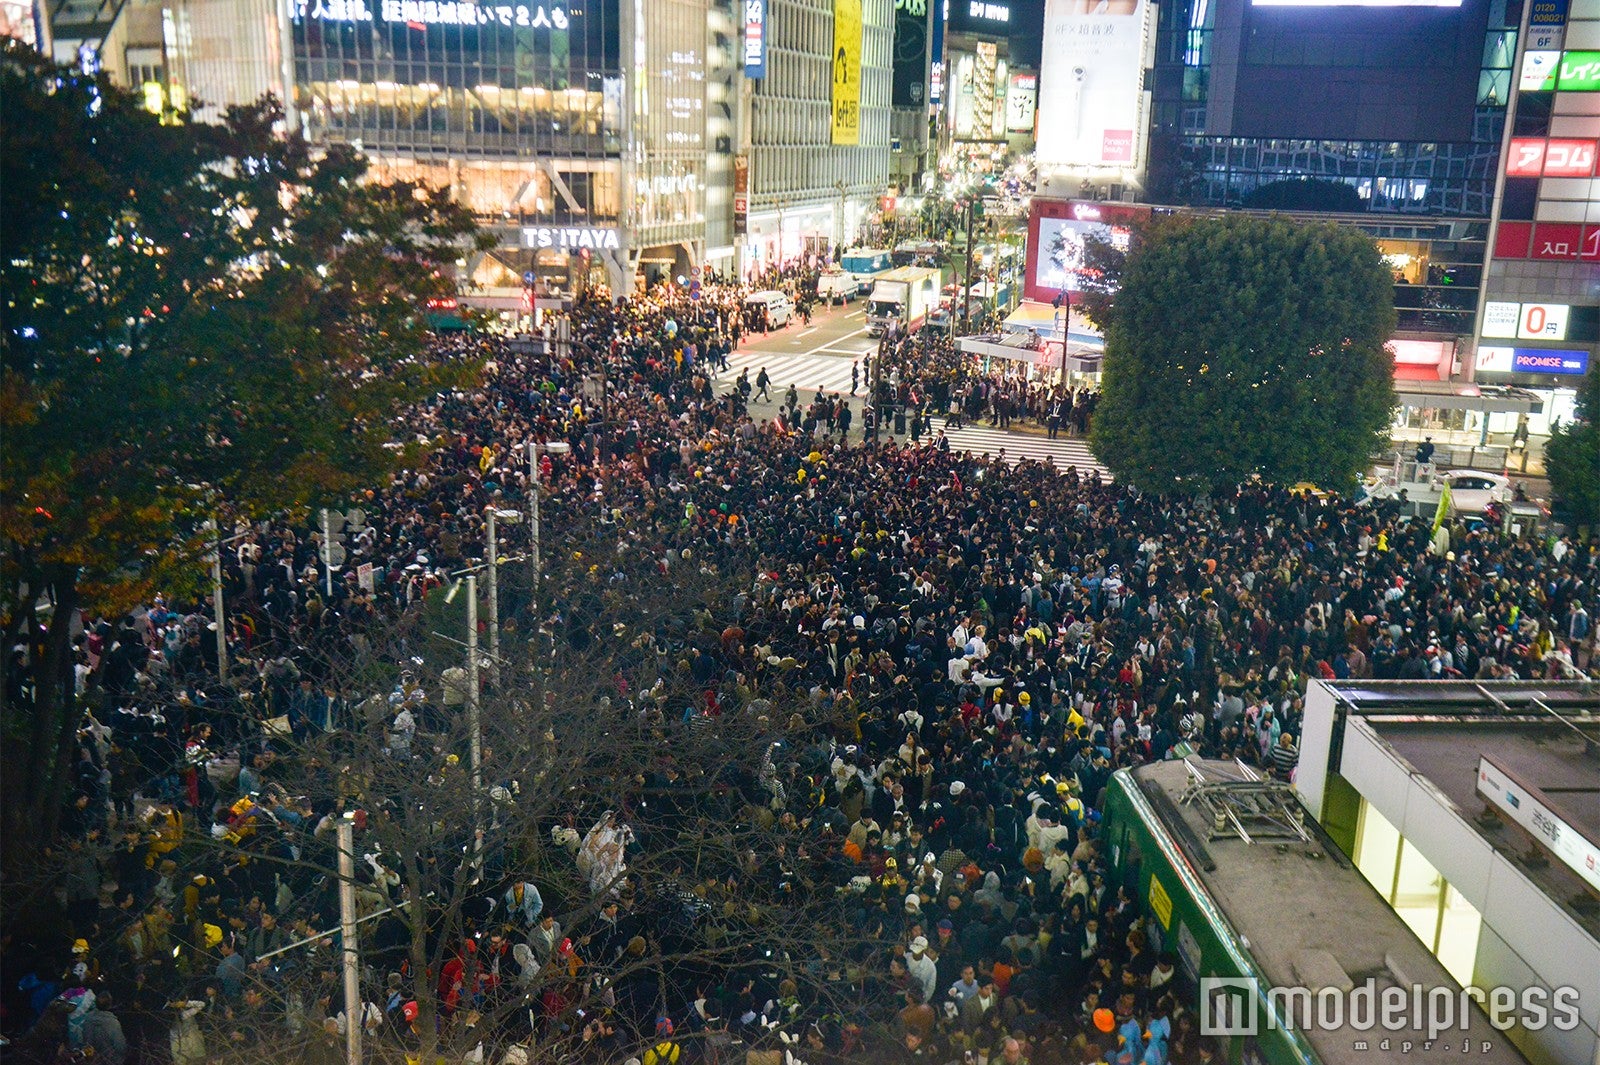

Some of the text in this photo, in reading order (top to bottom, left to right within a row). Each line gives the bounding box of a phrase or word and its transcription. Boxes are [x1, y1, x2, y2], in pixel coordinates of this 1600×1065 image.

[1537, 37, 1551, 46] 6F
[1517, 147, 1591, 168] アコム
[1541, 242, 1568, 255] 入口
[1516, 355, 1562, 368] PROMISE
